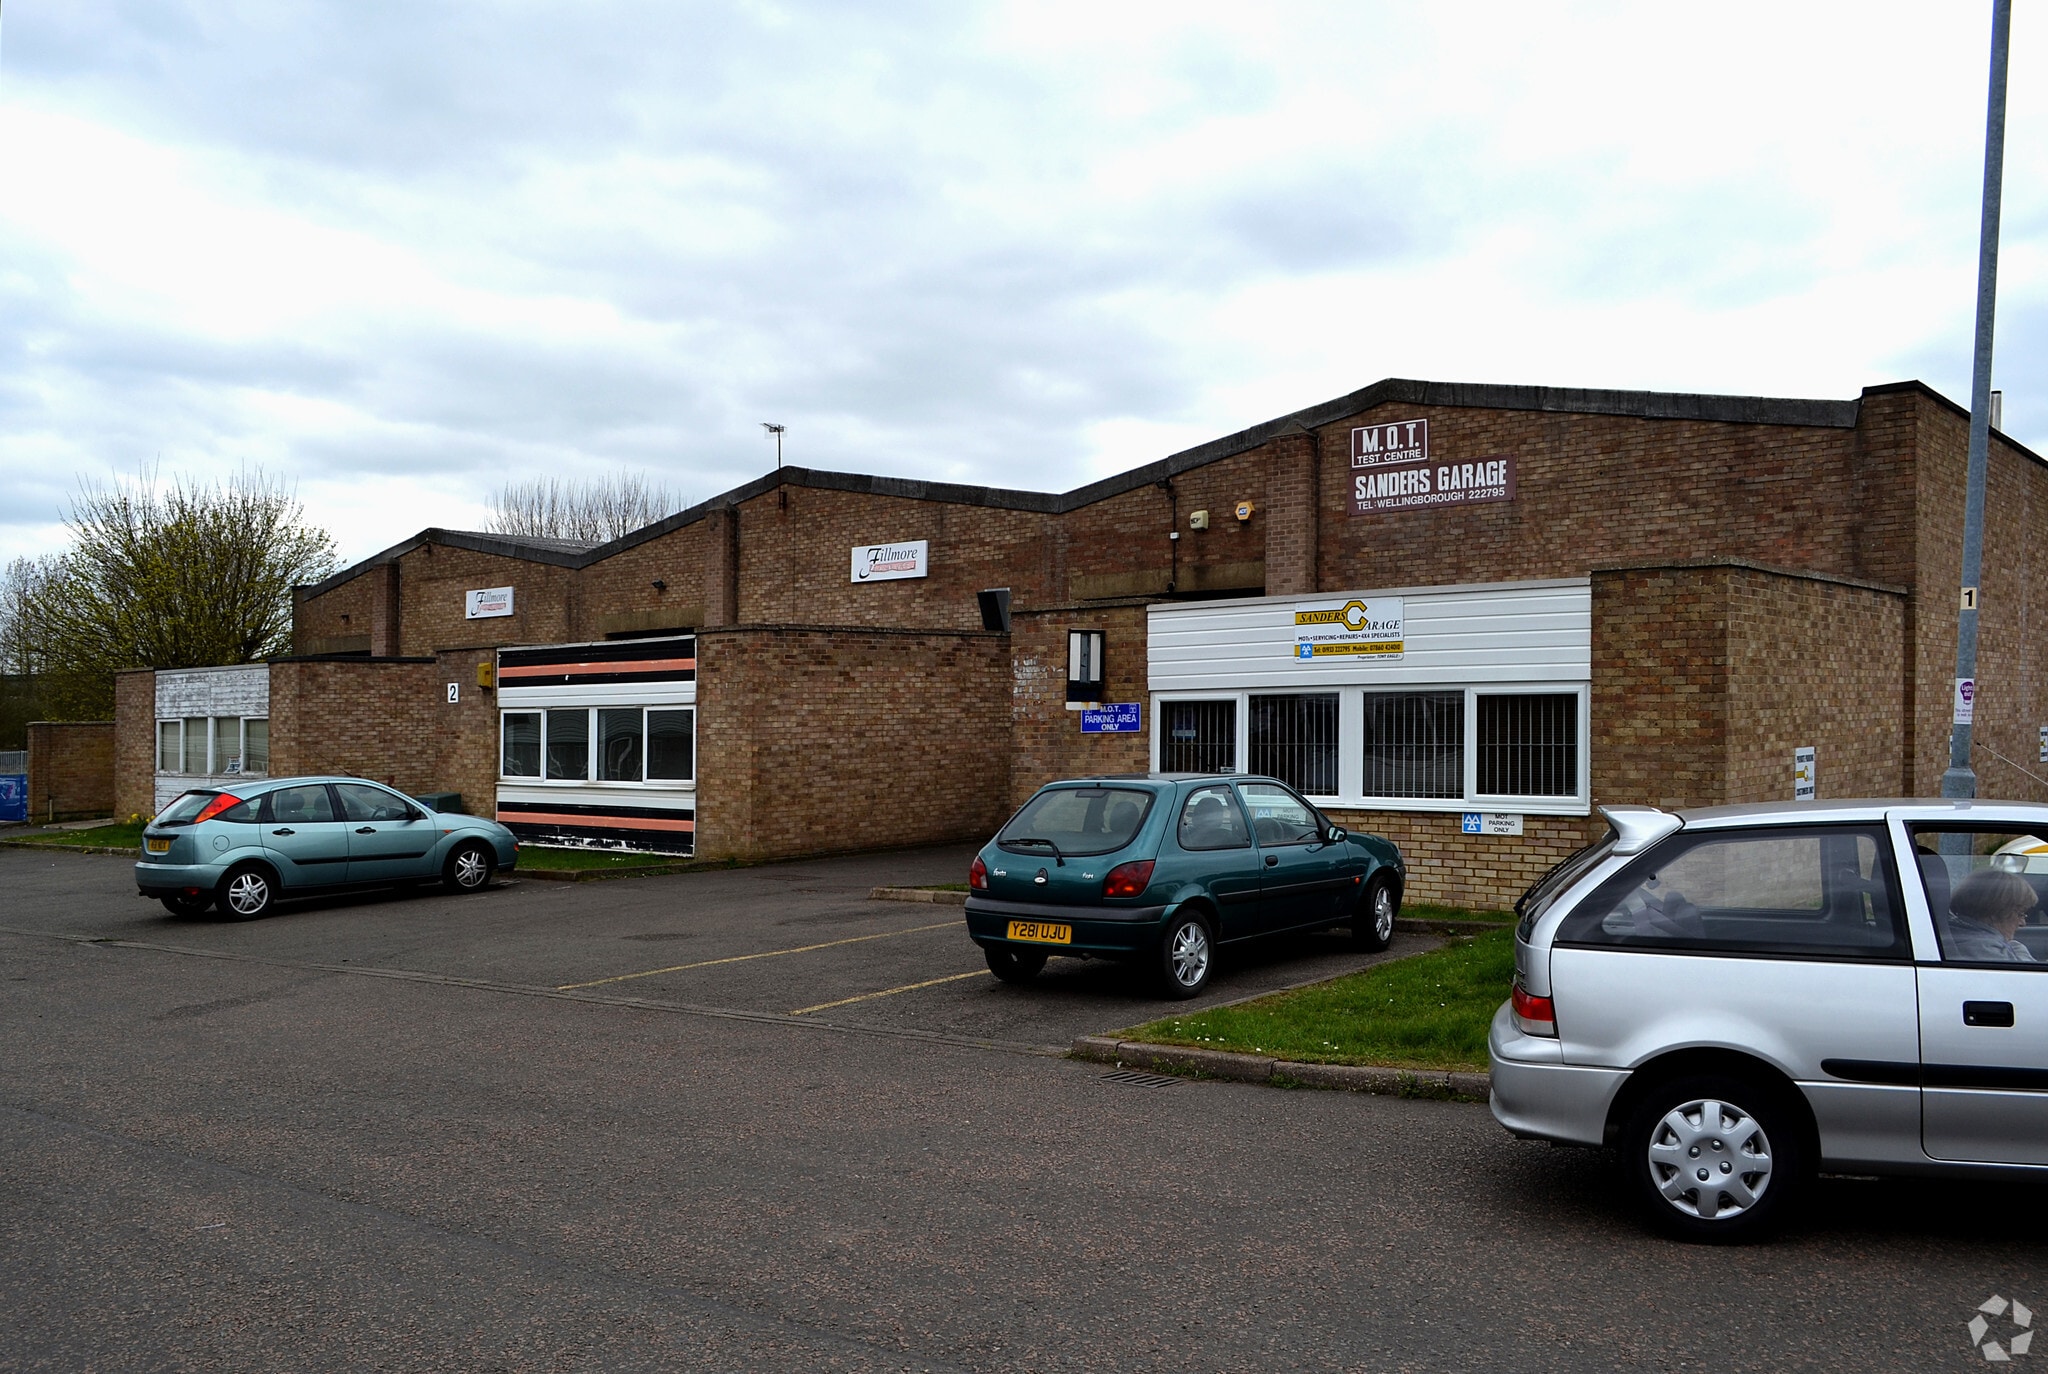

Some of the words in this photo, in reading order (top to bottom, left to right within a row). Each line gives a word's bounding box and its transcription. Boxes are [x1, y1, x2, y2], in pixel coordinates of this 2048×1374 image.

[1362, 423, 1420, 453] M.O.T.
[1357, 454, 1380, 465] TEST
[1384, 449, 1421, 462] CENTRE
[1355, 468, 1431, 500] SANDERS
[1437, 460, 1507, 491] GARAGE
[1468, 487, 1505, 499] 222795
[859, 547, 918, 579] Fillmore
[1964, 590, 1973, 607] 1
[1300, 612, 1347, 623] SANDERS
[450, 685, 456, 701] 2
[1084, 714, 1115, 724] PARKING
[1117, 714, 1137, 723] AREA
[1101, 723, 1120, 731] ONLY
[1013, 922, 1039, 938] Y281
[1041, 924, 1067, 940] UJU
